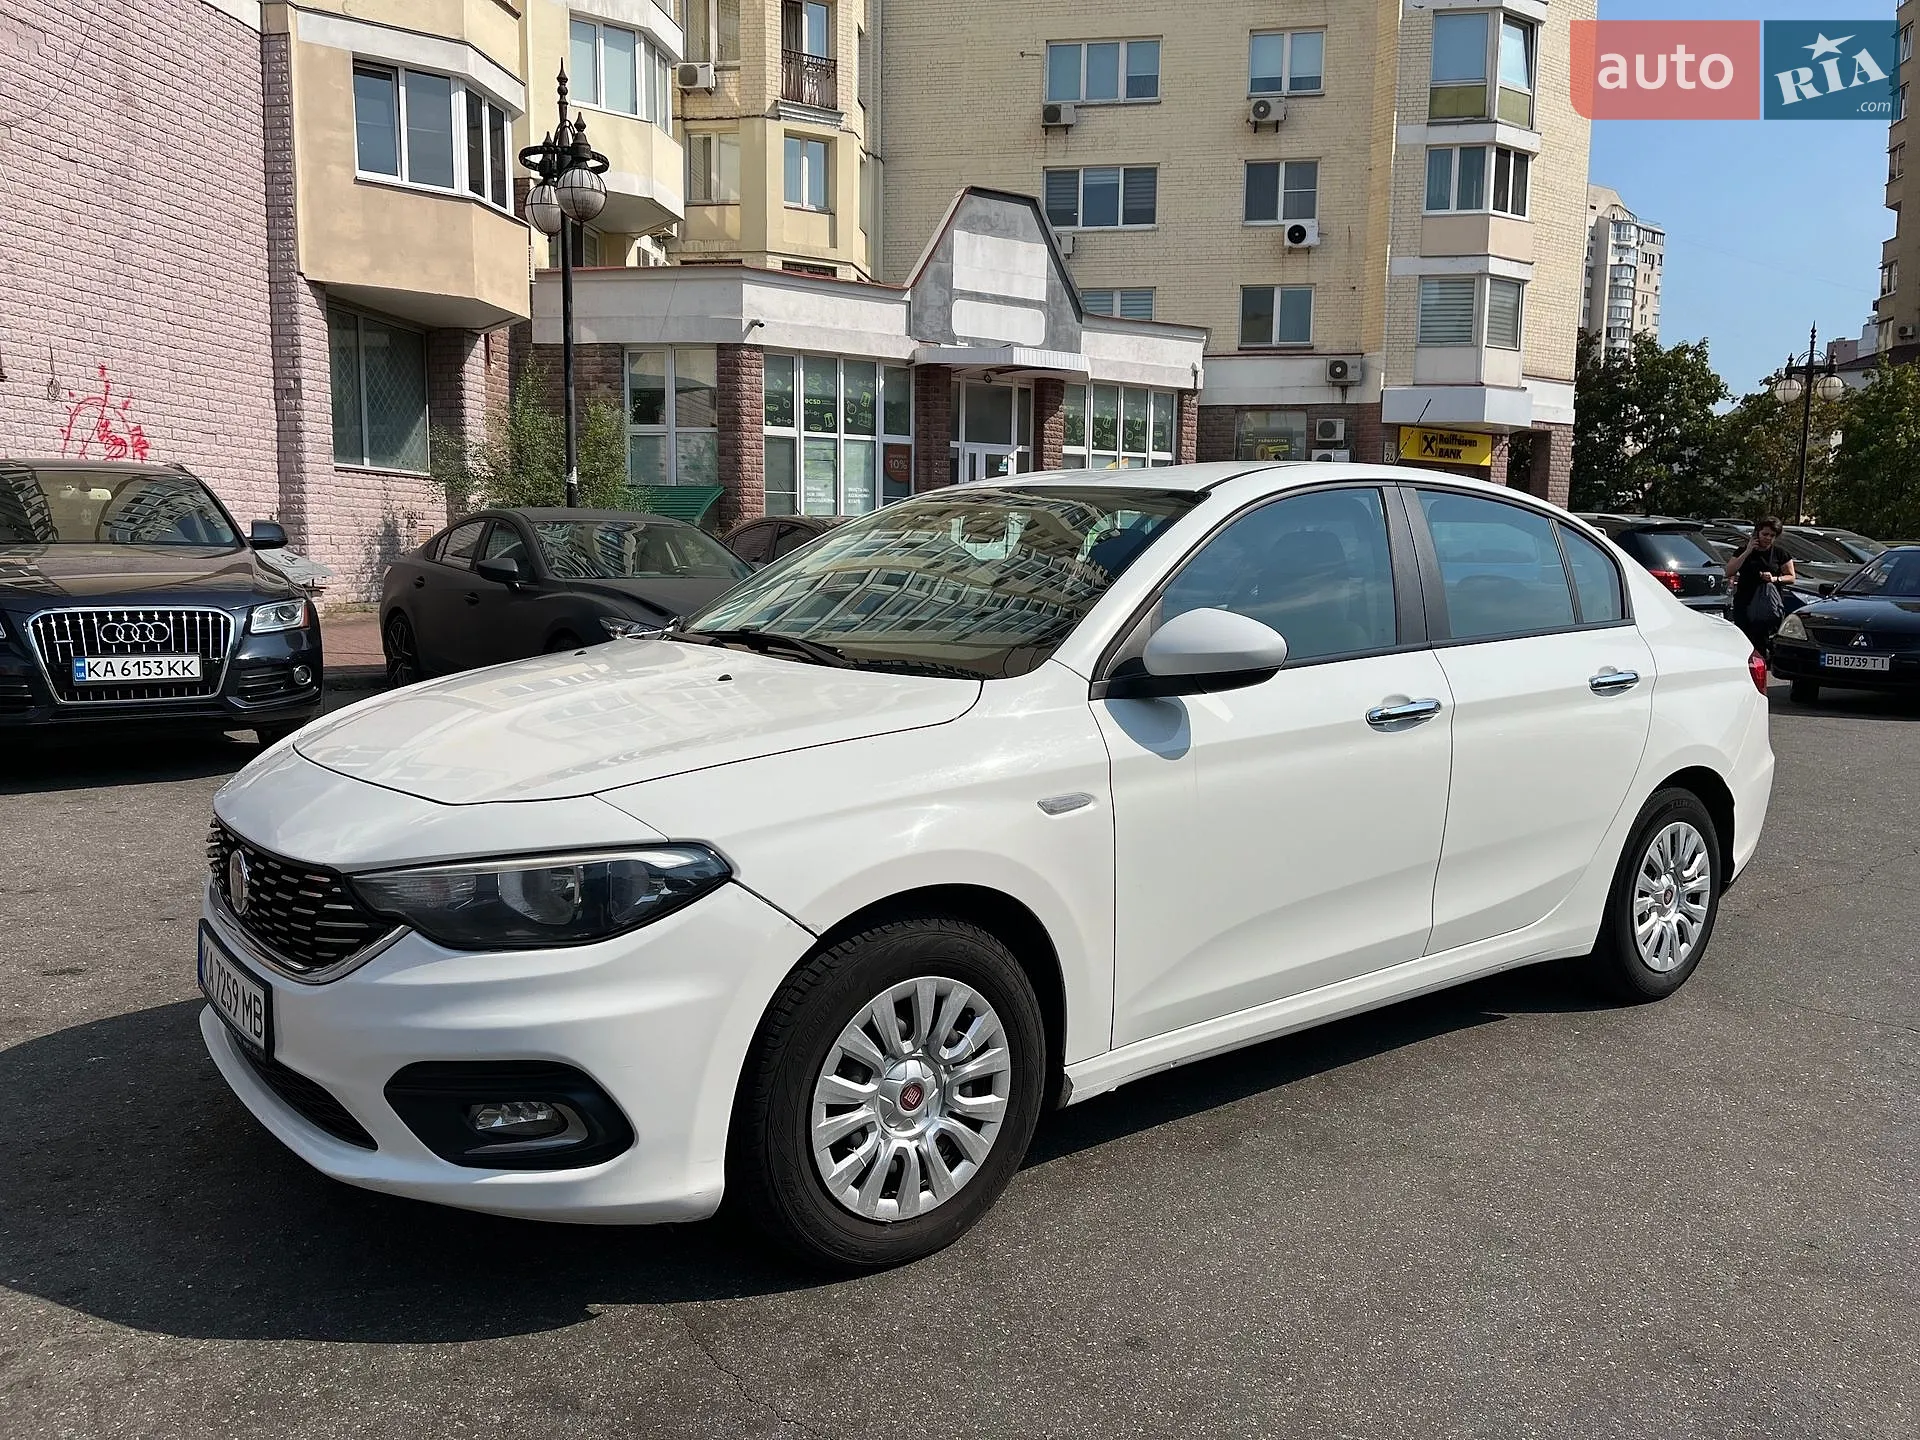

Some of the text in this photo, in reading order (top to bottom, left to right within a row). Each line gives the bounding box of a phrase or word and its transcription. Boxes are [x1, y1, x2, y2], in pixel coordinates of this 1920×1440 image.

[1438, 447, 1463, 460] BANK
[87, 660, 196, 678] KA 6153 KK
[1826, 655, 1842, 667] BH
[1843, 656, 1868, 668] 8739
[215, 958, 239, 1018] 7259
[241, 985, 263, 1039] MB
